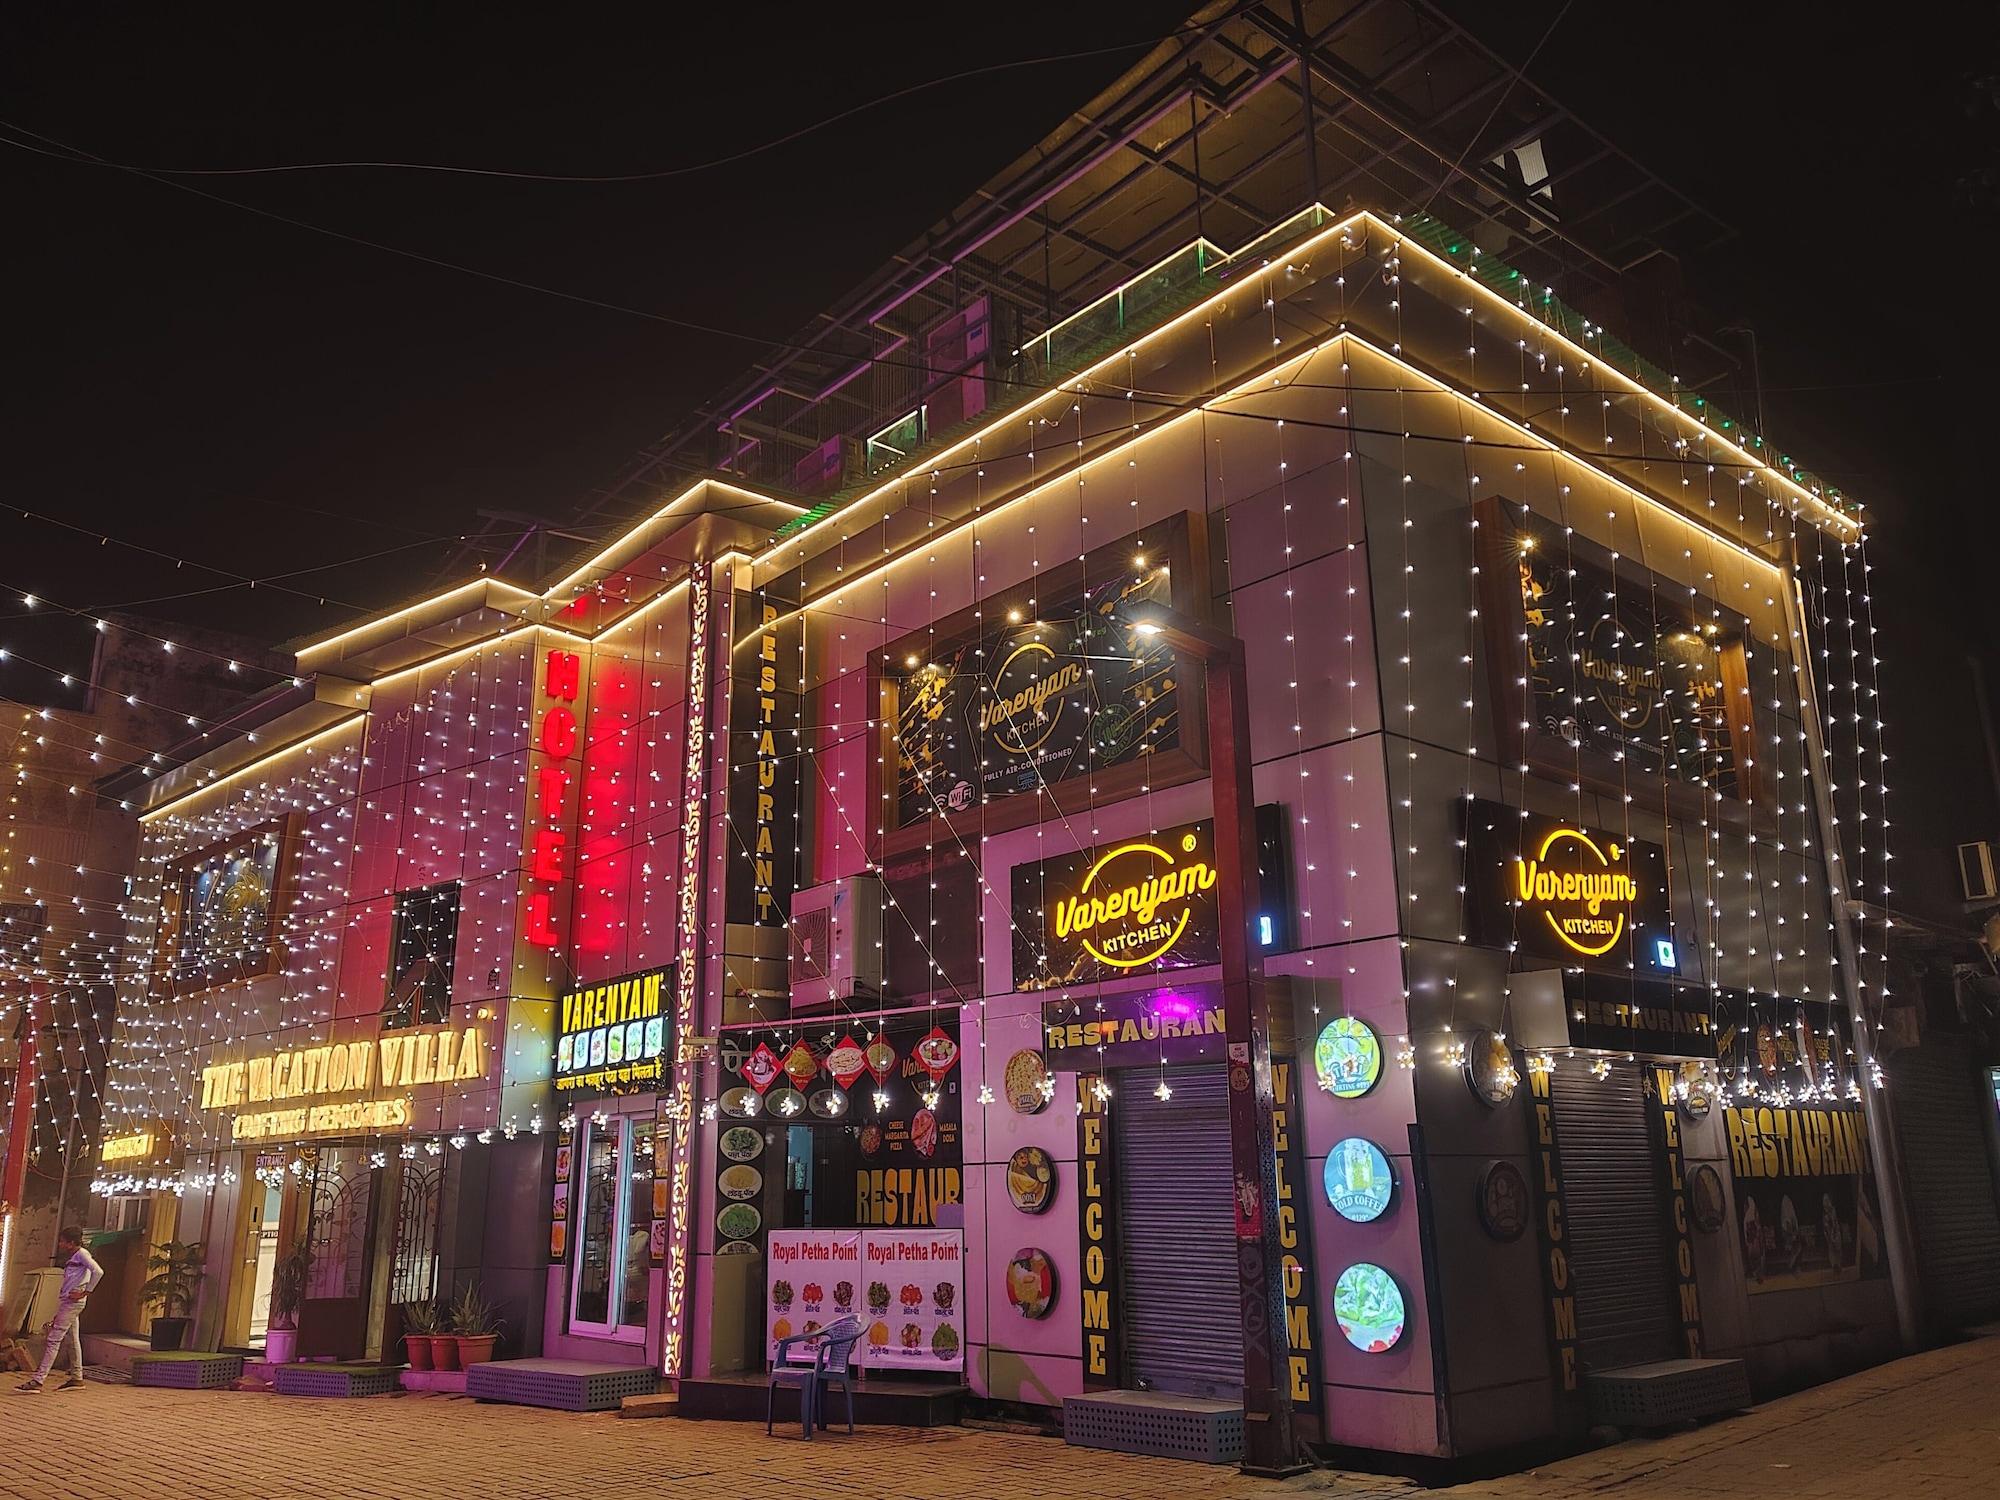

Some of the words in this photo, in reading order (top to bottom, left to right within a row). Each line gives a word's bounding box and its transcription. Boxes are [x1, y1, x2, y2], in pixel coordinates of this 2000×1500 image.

[981, 662, 1083, 731] Varenyam
[1006, 711, 1050, 743] KITCHEN
[757, 605, 778, 920] RESTAURANT
[983, 768, 1004, 783] FULLY
[1005, 747, 1073, 777] AIR-CONDITIONED
[529, 649, 580, 946] HOTEL
[1055, 863, 1217, 938] Varenyam
[1519, 860, 1637, 916] Varenyam
[1103, 921, 1172, 954] KITCHEN
[1562, 918, 1614, 935] KITCHEN
[562, 974, 660, 1033] VARENYAM
[1572, 999, 1710, 1036] RESTAURANT
[247, 1041, 372, 1102] VACATION
[379, 1027, 480, 1088] VILLA
[1727, 1107, 1870, 1178] RESTAURANT
[856, 1167, 960, 1226] RESTAUR
[1077, 1077, 1110, 1375] WELCOME
[1354, 1195, 1384, 1213] COFFEE
[1529, 1058, 1577, 1391] WELCOME
[1656, 1069, 1698, 1358] WELCOME
[773, 1242, 799, 1264] Royal
[801, 1242, 829, 1261] Petha
[832, 1242, 858, 1261] Point
[867, 1242, 895, 1265] Royal
[898, 1242, 928, 1261] Petha
[931, 1242, 959, 1261] Point
